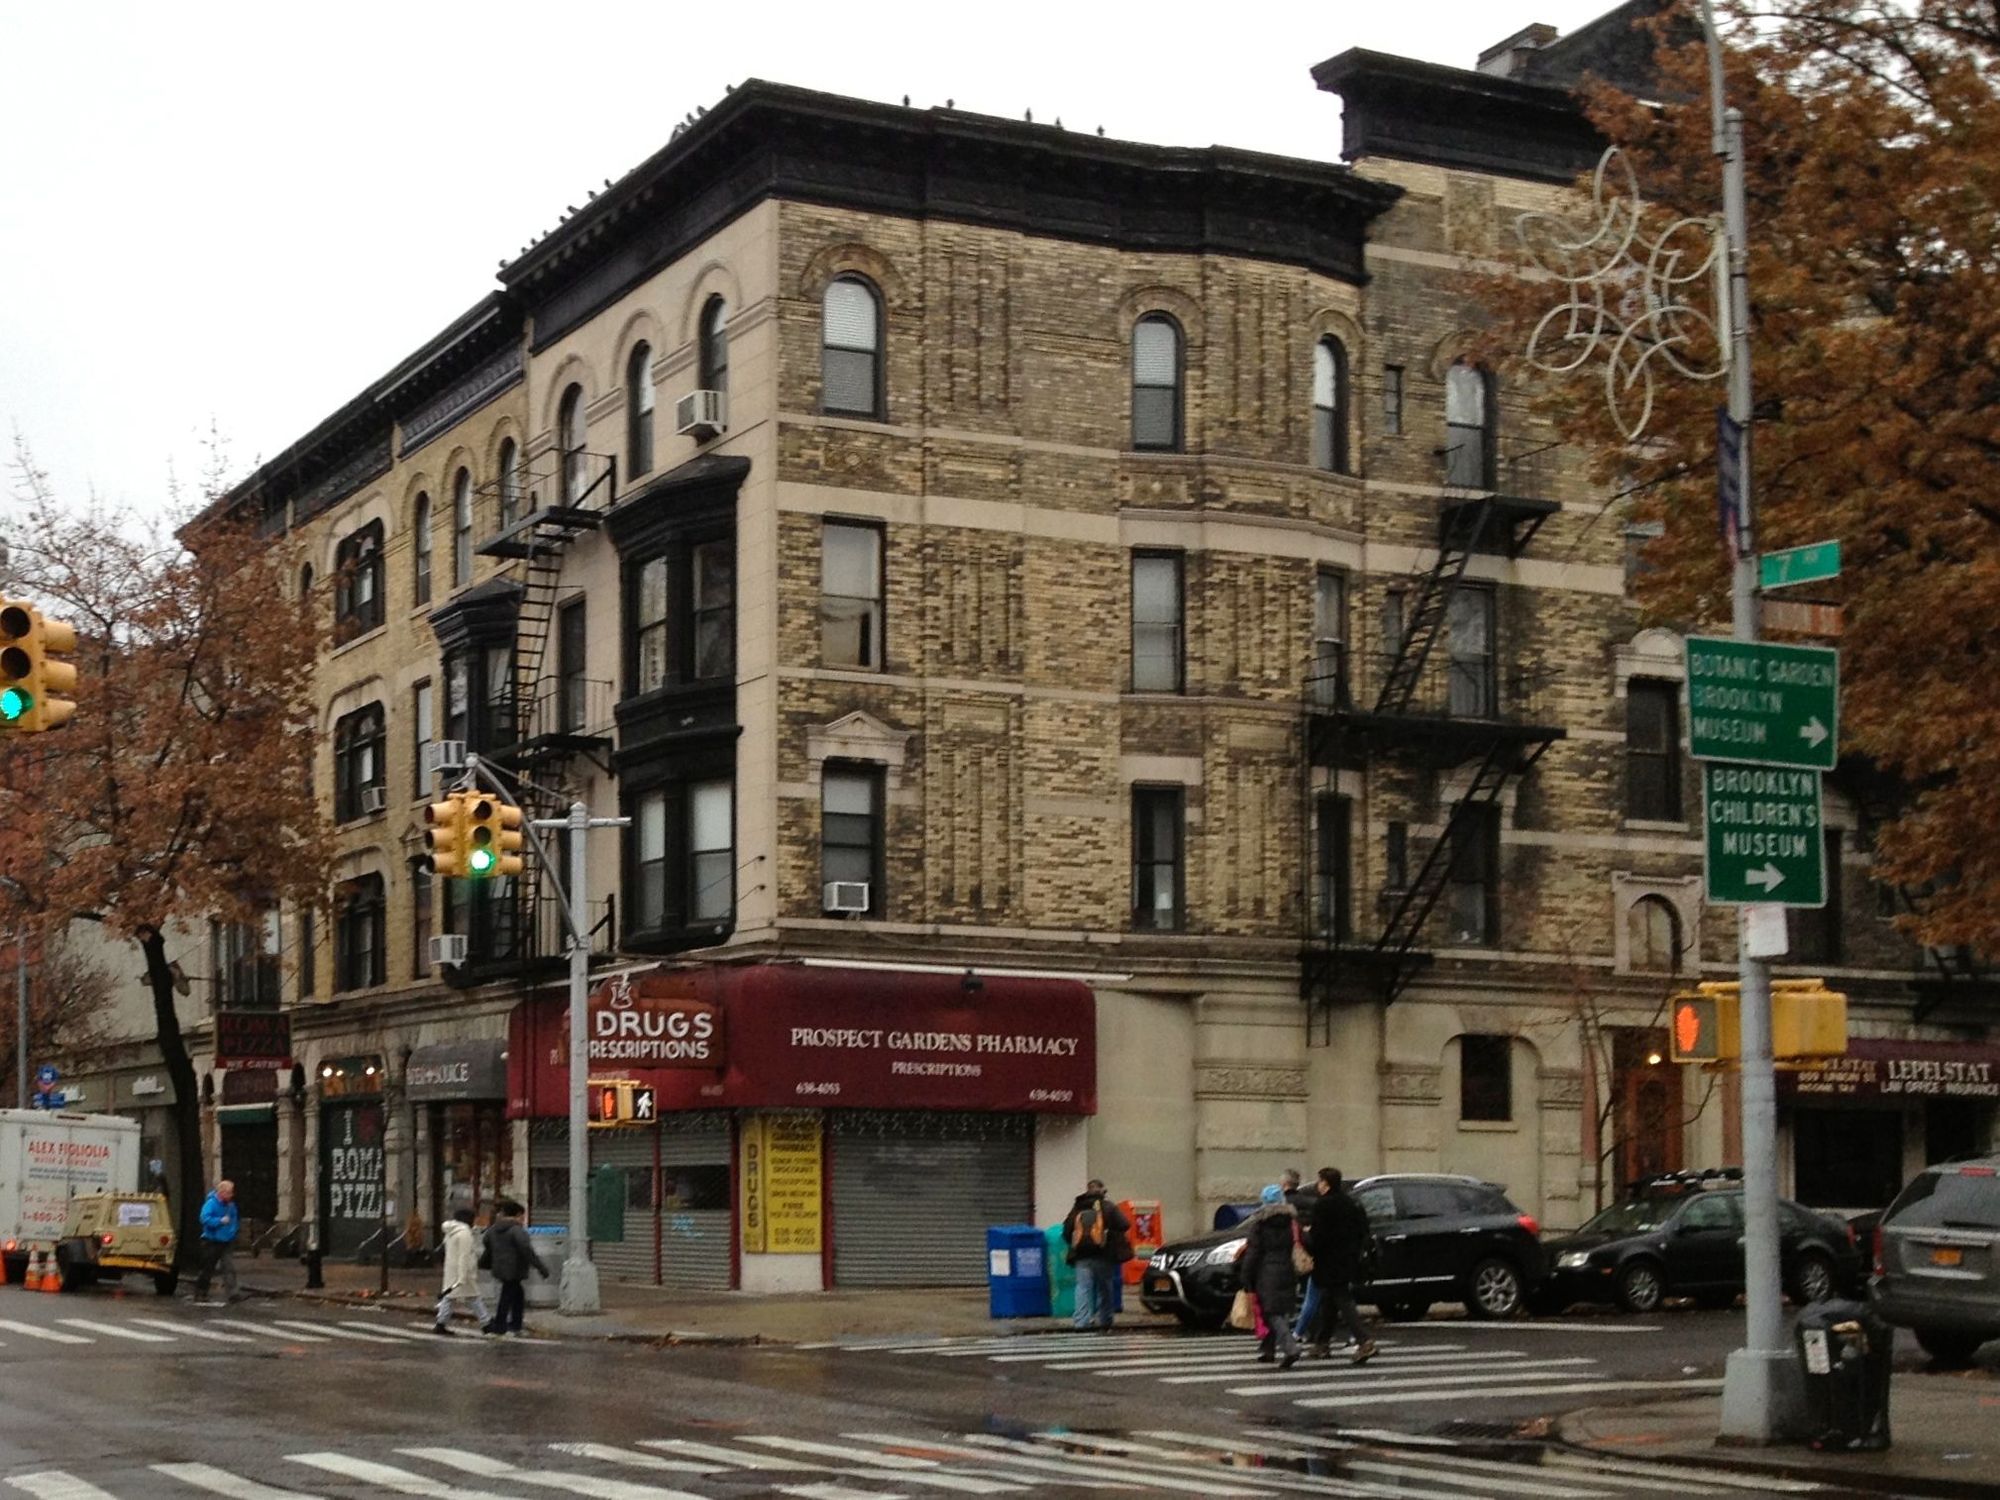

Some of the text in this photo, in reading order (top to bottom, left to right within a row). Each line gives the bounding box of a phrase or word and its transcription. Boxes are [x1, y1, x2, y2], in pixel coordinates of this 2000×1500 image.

[1775, 554, 1792, 581] 7
[1767, 659, 1834, 687] GARDEN
[1692, 684, 1783, 714] BROOKLYN
[1693, 716, 1767, 744] MUSEUM
[1712, 769, 1814, 796] BROOKLYN
[1710, 800, 1817, 828] CHILDREN'S
[1723, 832, 1807, 858] MUSEUM
[596, 1010, 713, 1039] DRUGS
[589, 1039, 709, 1060] RESCRIPTIONS
[790, 1027, 1079, 1056] PROSPECT GARDENS PHARMACY
[892, 1061, 982, 1077] PRESCRIPTIONS
[1888, 1060, 1992, 1082] LEPELSTAT
[28, 1140, 55, 1155] ALEX
